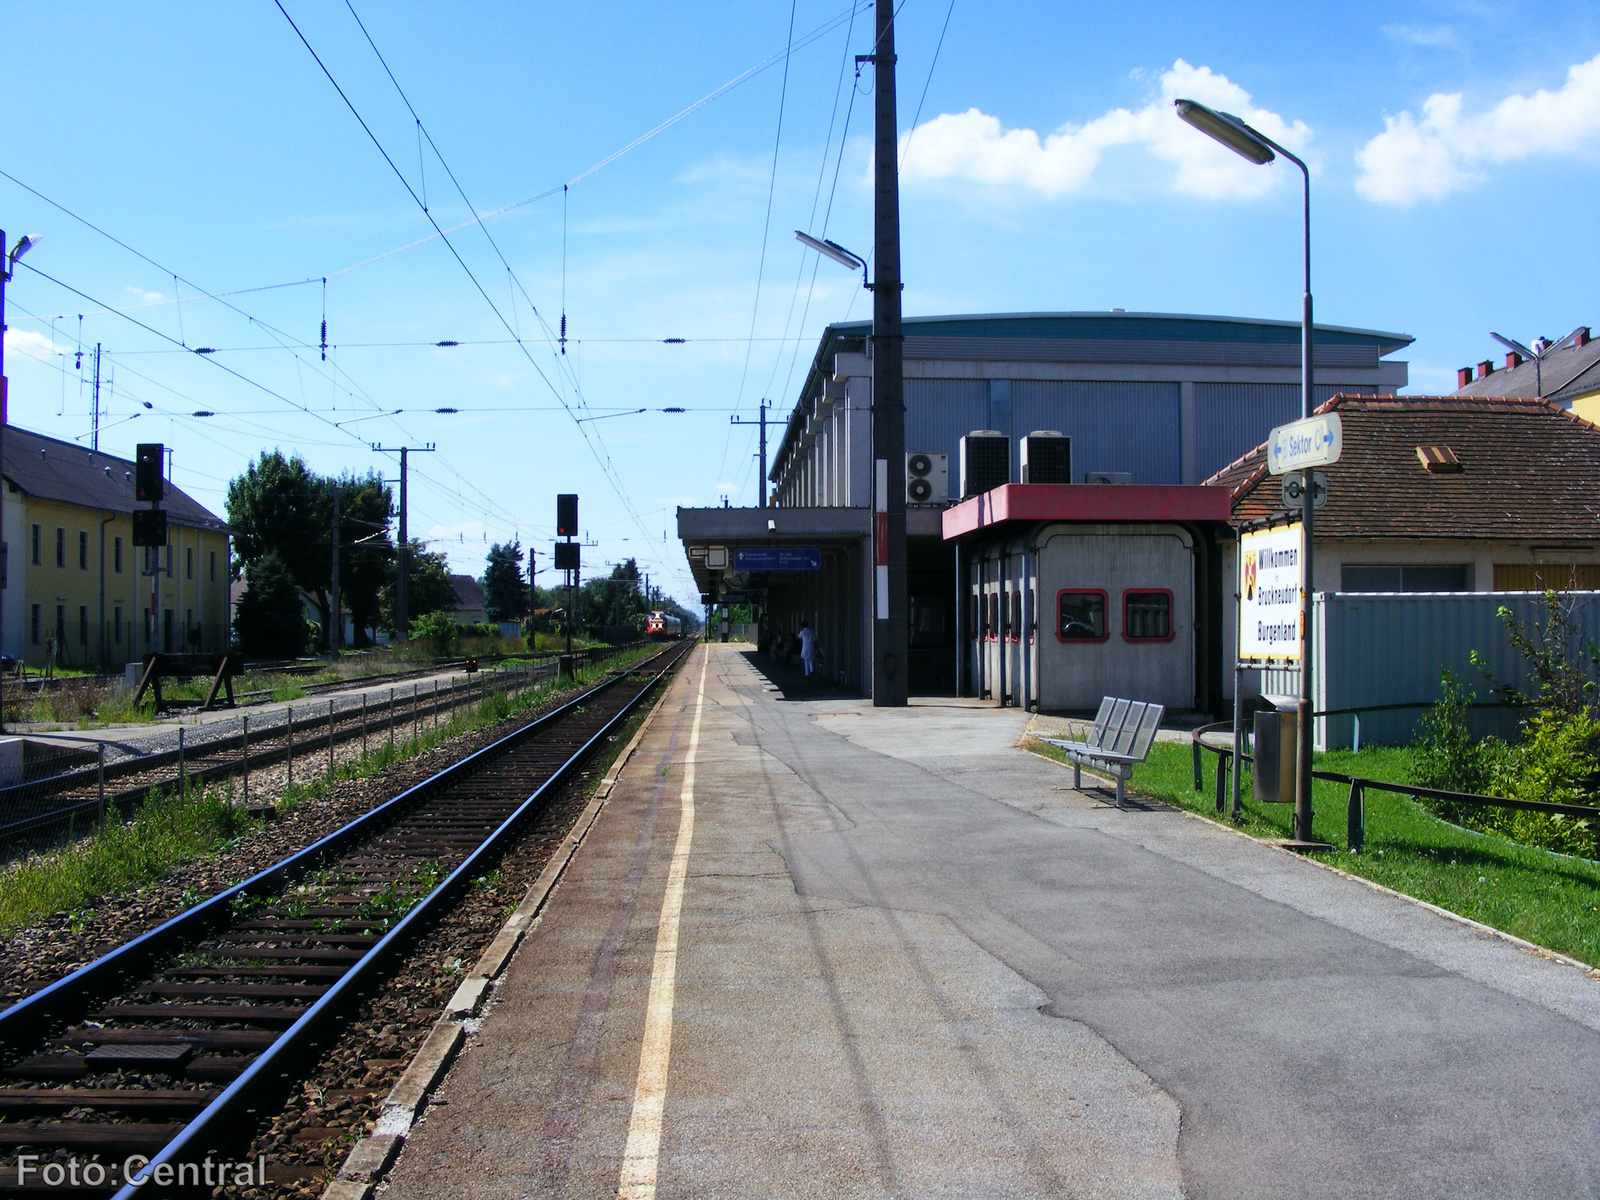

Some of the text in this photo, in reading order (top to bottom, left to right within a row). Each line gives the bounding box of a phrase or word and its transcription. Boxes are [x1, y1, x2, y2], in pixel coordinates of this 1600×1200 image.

[1289, 434, 1312, 457] Sektor
[1315, 428, 1321, 451] C
[1258, 548, 1298, 570] Willkommen
[1258, 583, 1297, 606] Bruckneudorf
[1257, 619, 1296, 645] Burgenland
